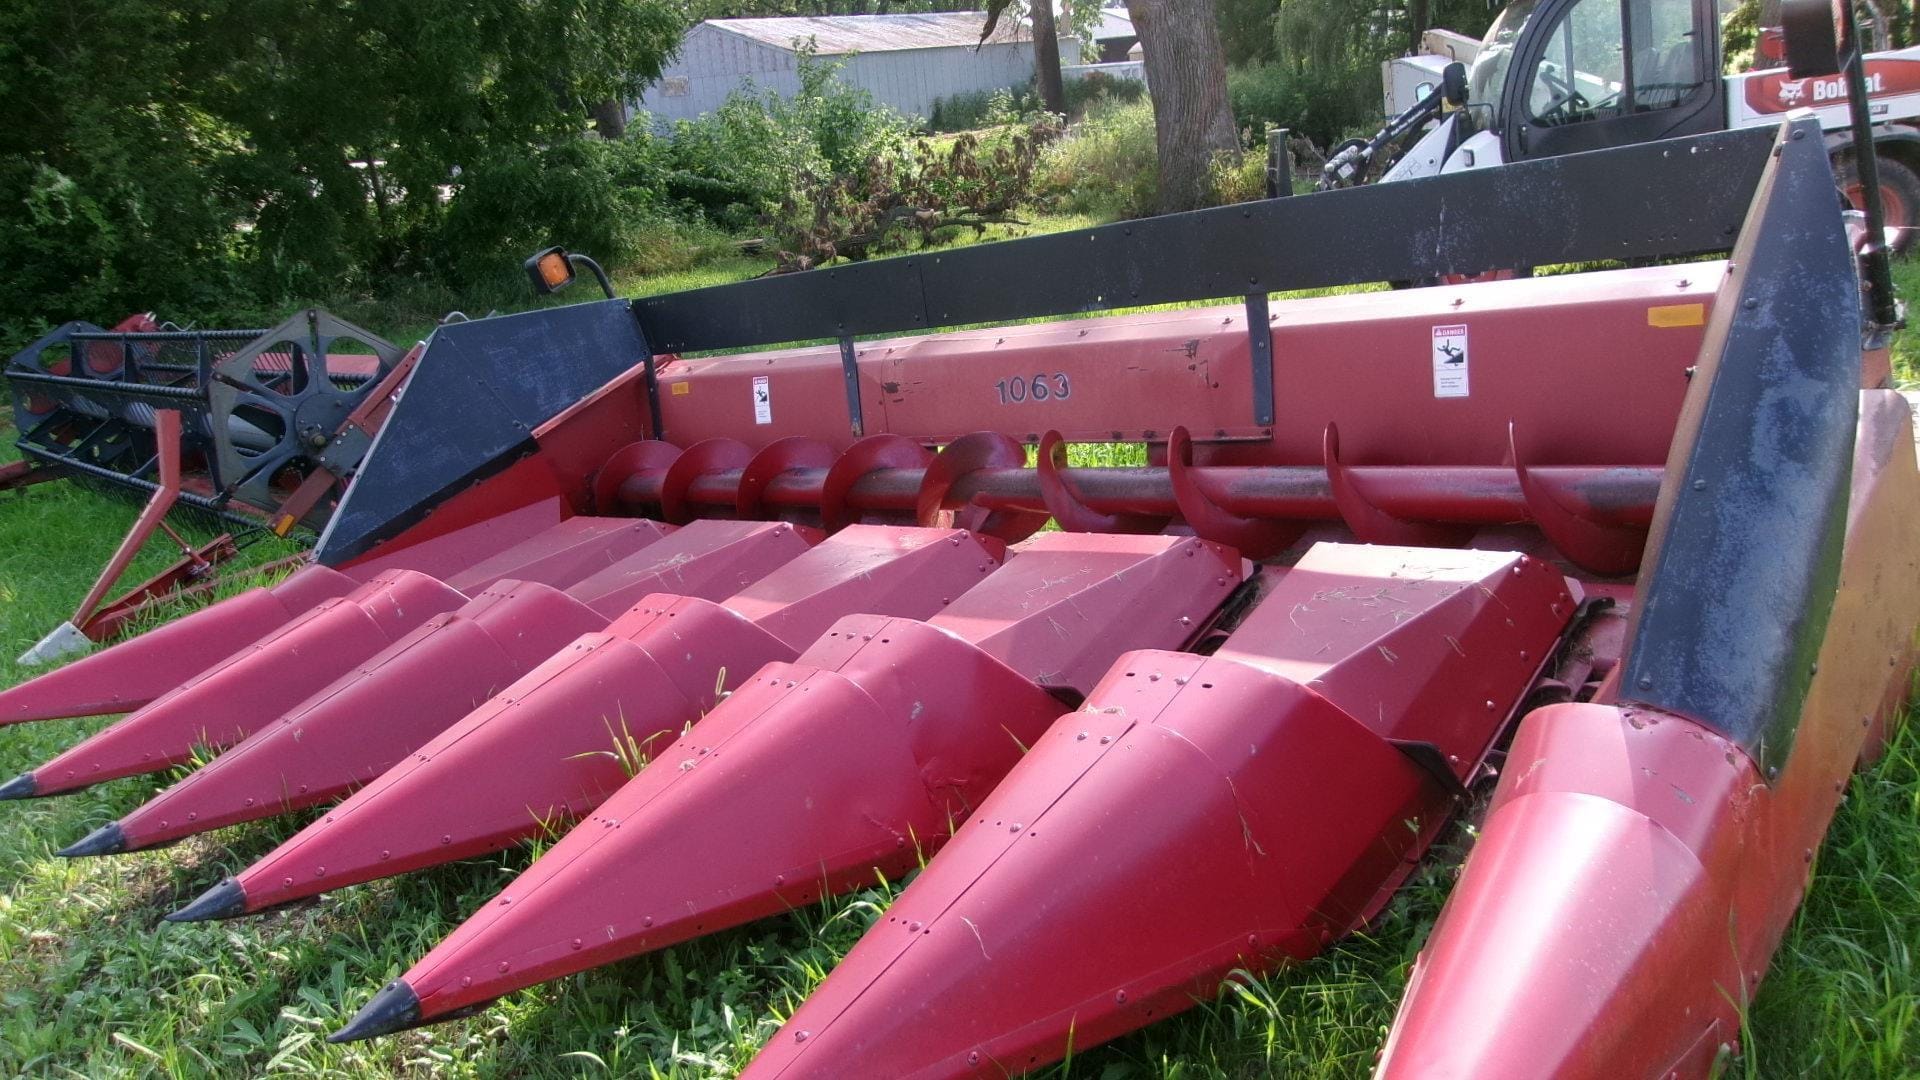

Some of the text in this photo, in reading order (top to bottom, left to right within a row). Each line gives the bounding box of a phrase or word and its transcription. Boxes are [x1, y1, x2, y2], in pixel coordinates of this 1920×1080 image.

[1813, 72, 1881, 100] Bobat
[1442, 328, 1464, 336] DANGER
[993, 373, 1070, 404] 1063
